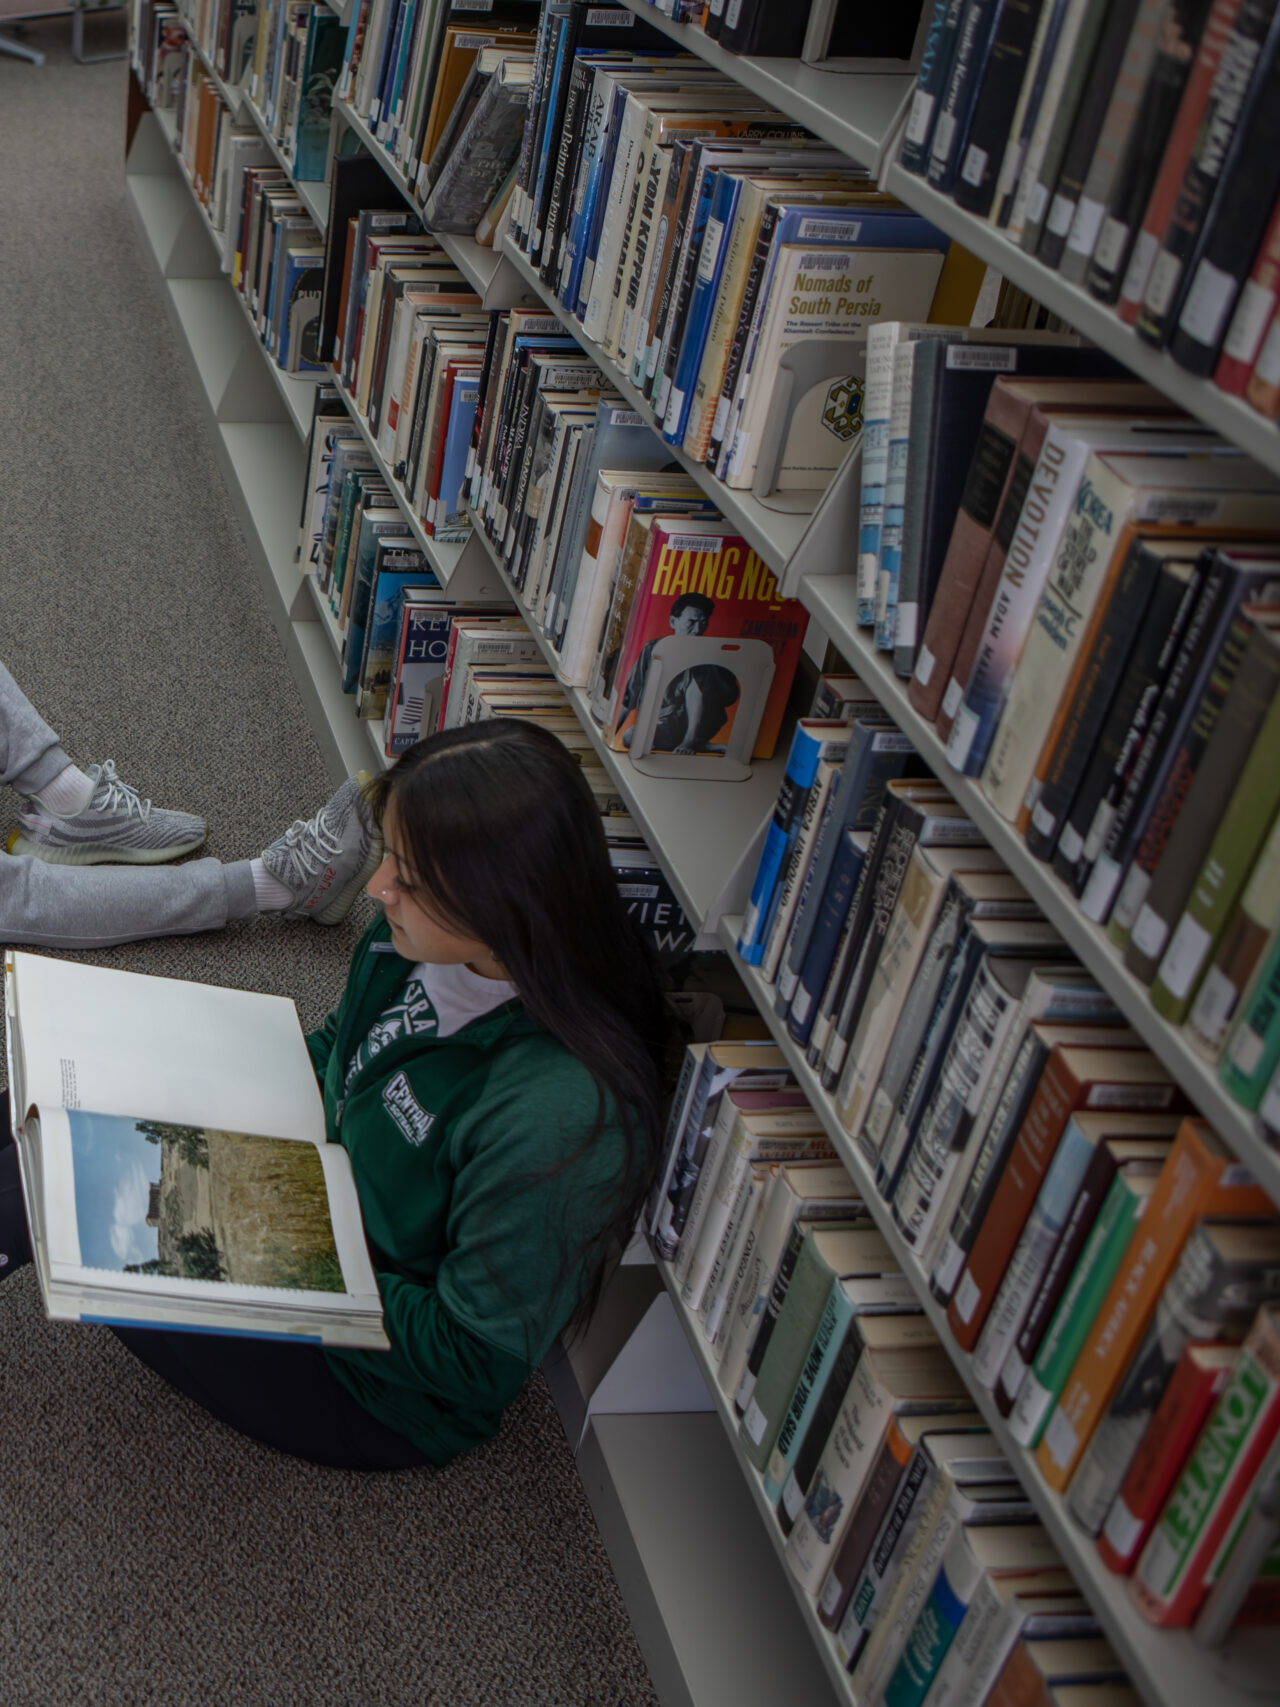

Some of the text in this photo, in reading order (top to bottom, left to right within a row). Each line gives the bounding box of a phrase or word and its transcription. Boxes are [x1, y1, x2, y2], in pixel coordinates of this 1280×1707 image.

[913, 1, 950, 93] ASAD
[563, 88, 577, 128] FROM
[586, 94, 605, 158] ARAB
[555, 129, 573, 177] Beirut
[617, 139, 635, 205] Dan Kurzman
[635, 151, 646, 174] O
[545, 196, 561, 232] Jerus
[640, 165, 661, 220] YOM
[683, 188, 699, 239] FRIEND
[624, 219, 651, 310] KIPPUR
[675, 242, 688, 280] ANNE
[725, 215, 745, 272] Looking
[665, 281, 680, 328] FRANK
[788, 296, 881, 316] South Persia
[793, 273, 874, 293] Nomads of
[709, 294, 727, 342] Dilmun
[720, 339, 743, 398] KING
[511, 402, 531, 450] INDIRA
[512, 444, 534, 513] GANDHI'S
[1002, 440, 1068, 589] DEVOTION
[651, 544, 738, 600] HAING
[986, 590, 1013, 639] ADAM
[799, 777, 824, 833] AFRICA
[778, 834, 807, 908] UNBOUND
[880, 829, 918, 910] SECRETS
[873, 908, 892, 935] OF
[383, 1071, 434, 1144] CENTRAL
[388, 1102, 416, 1140] SOFTBALL
[733, 1228, 758, 1278] CONGO
[772, 1340, 827, 1458] MOVE YOUR SHAD
[917, 1514, 954, 1576] SOUTH
[891, 1574, 927, 1637] PACIFIC
